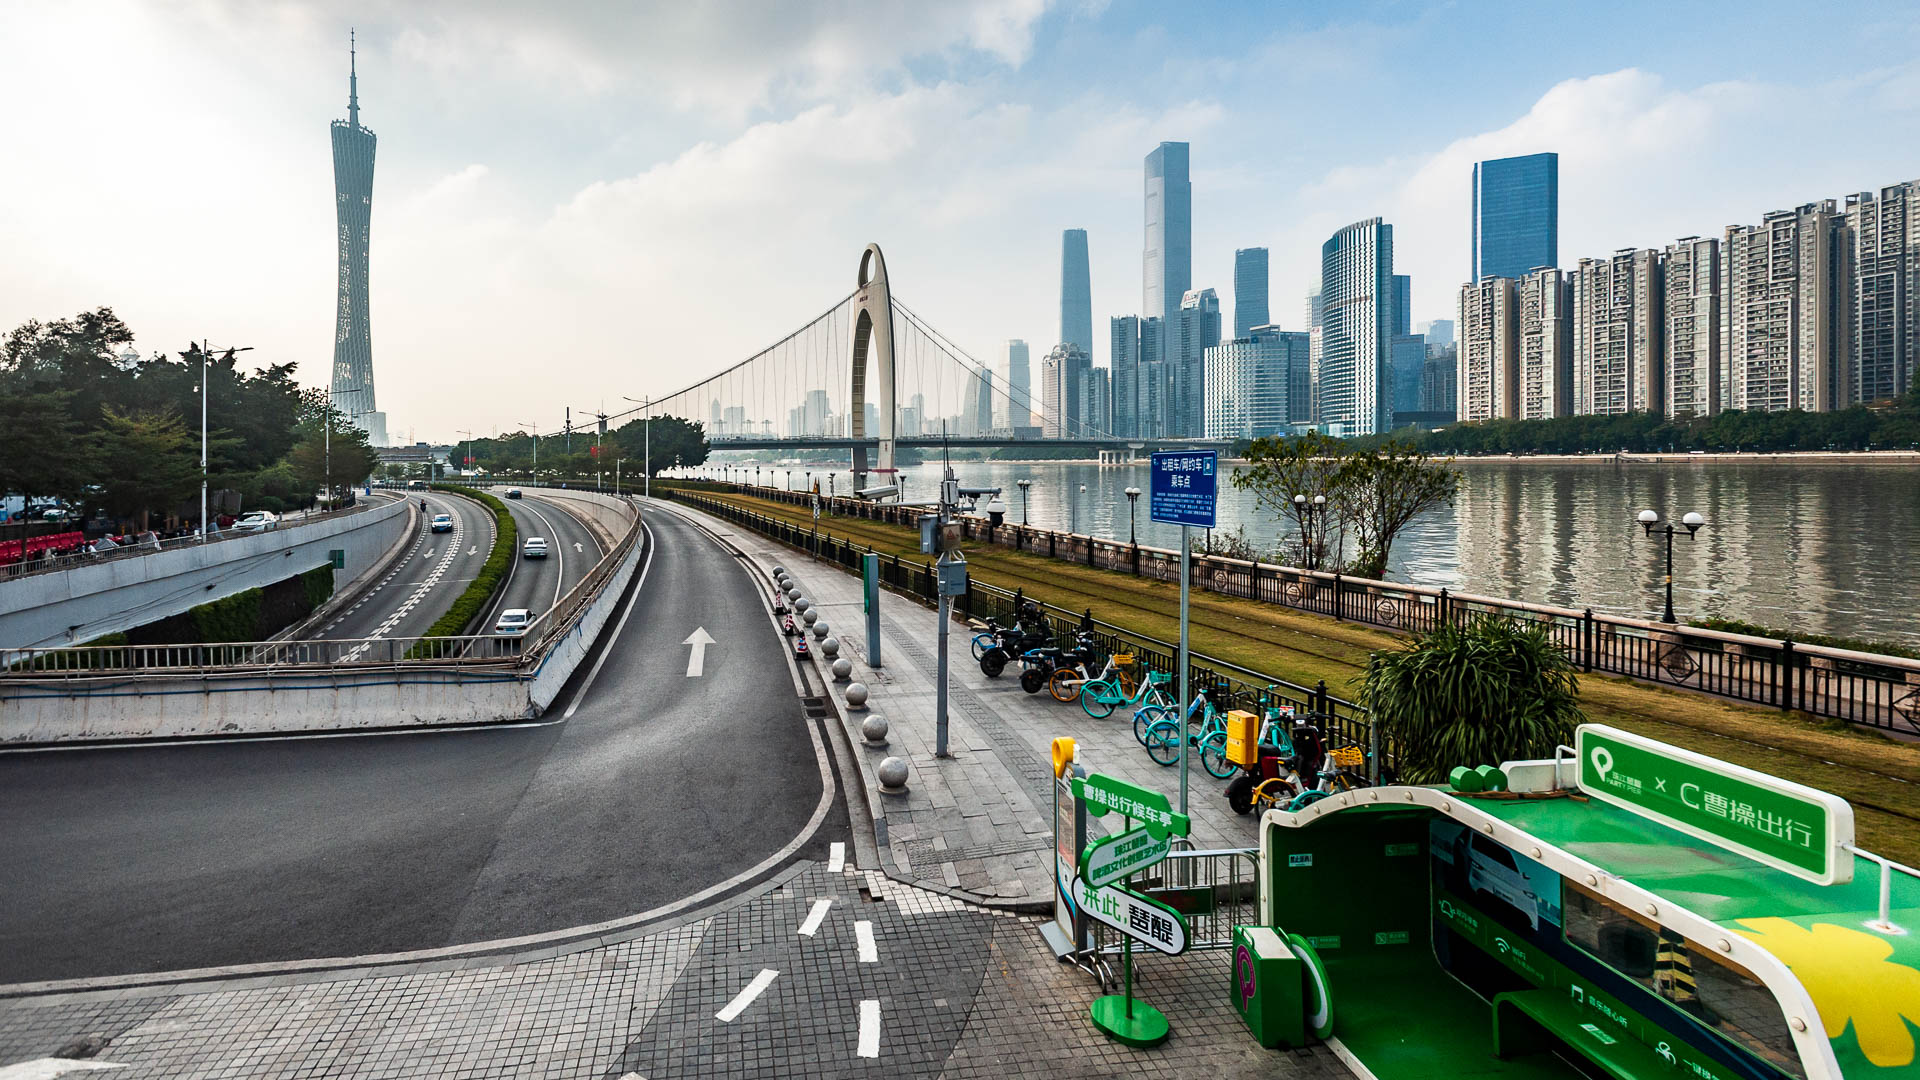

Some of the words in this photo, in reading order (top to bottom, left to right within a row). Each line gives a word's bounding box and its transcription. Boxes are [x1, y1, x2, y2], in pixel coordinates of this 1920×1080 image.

[1171, 474, 1191, 488] 乘车点
[1606, 777, 1626, 789] PARTY
[1627, 784, 1641, 795] PIER
[1083, 783, 1173, 828] 曹操出行候车亭
[1704, 790, 1812, 848] 曹操出行
